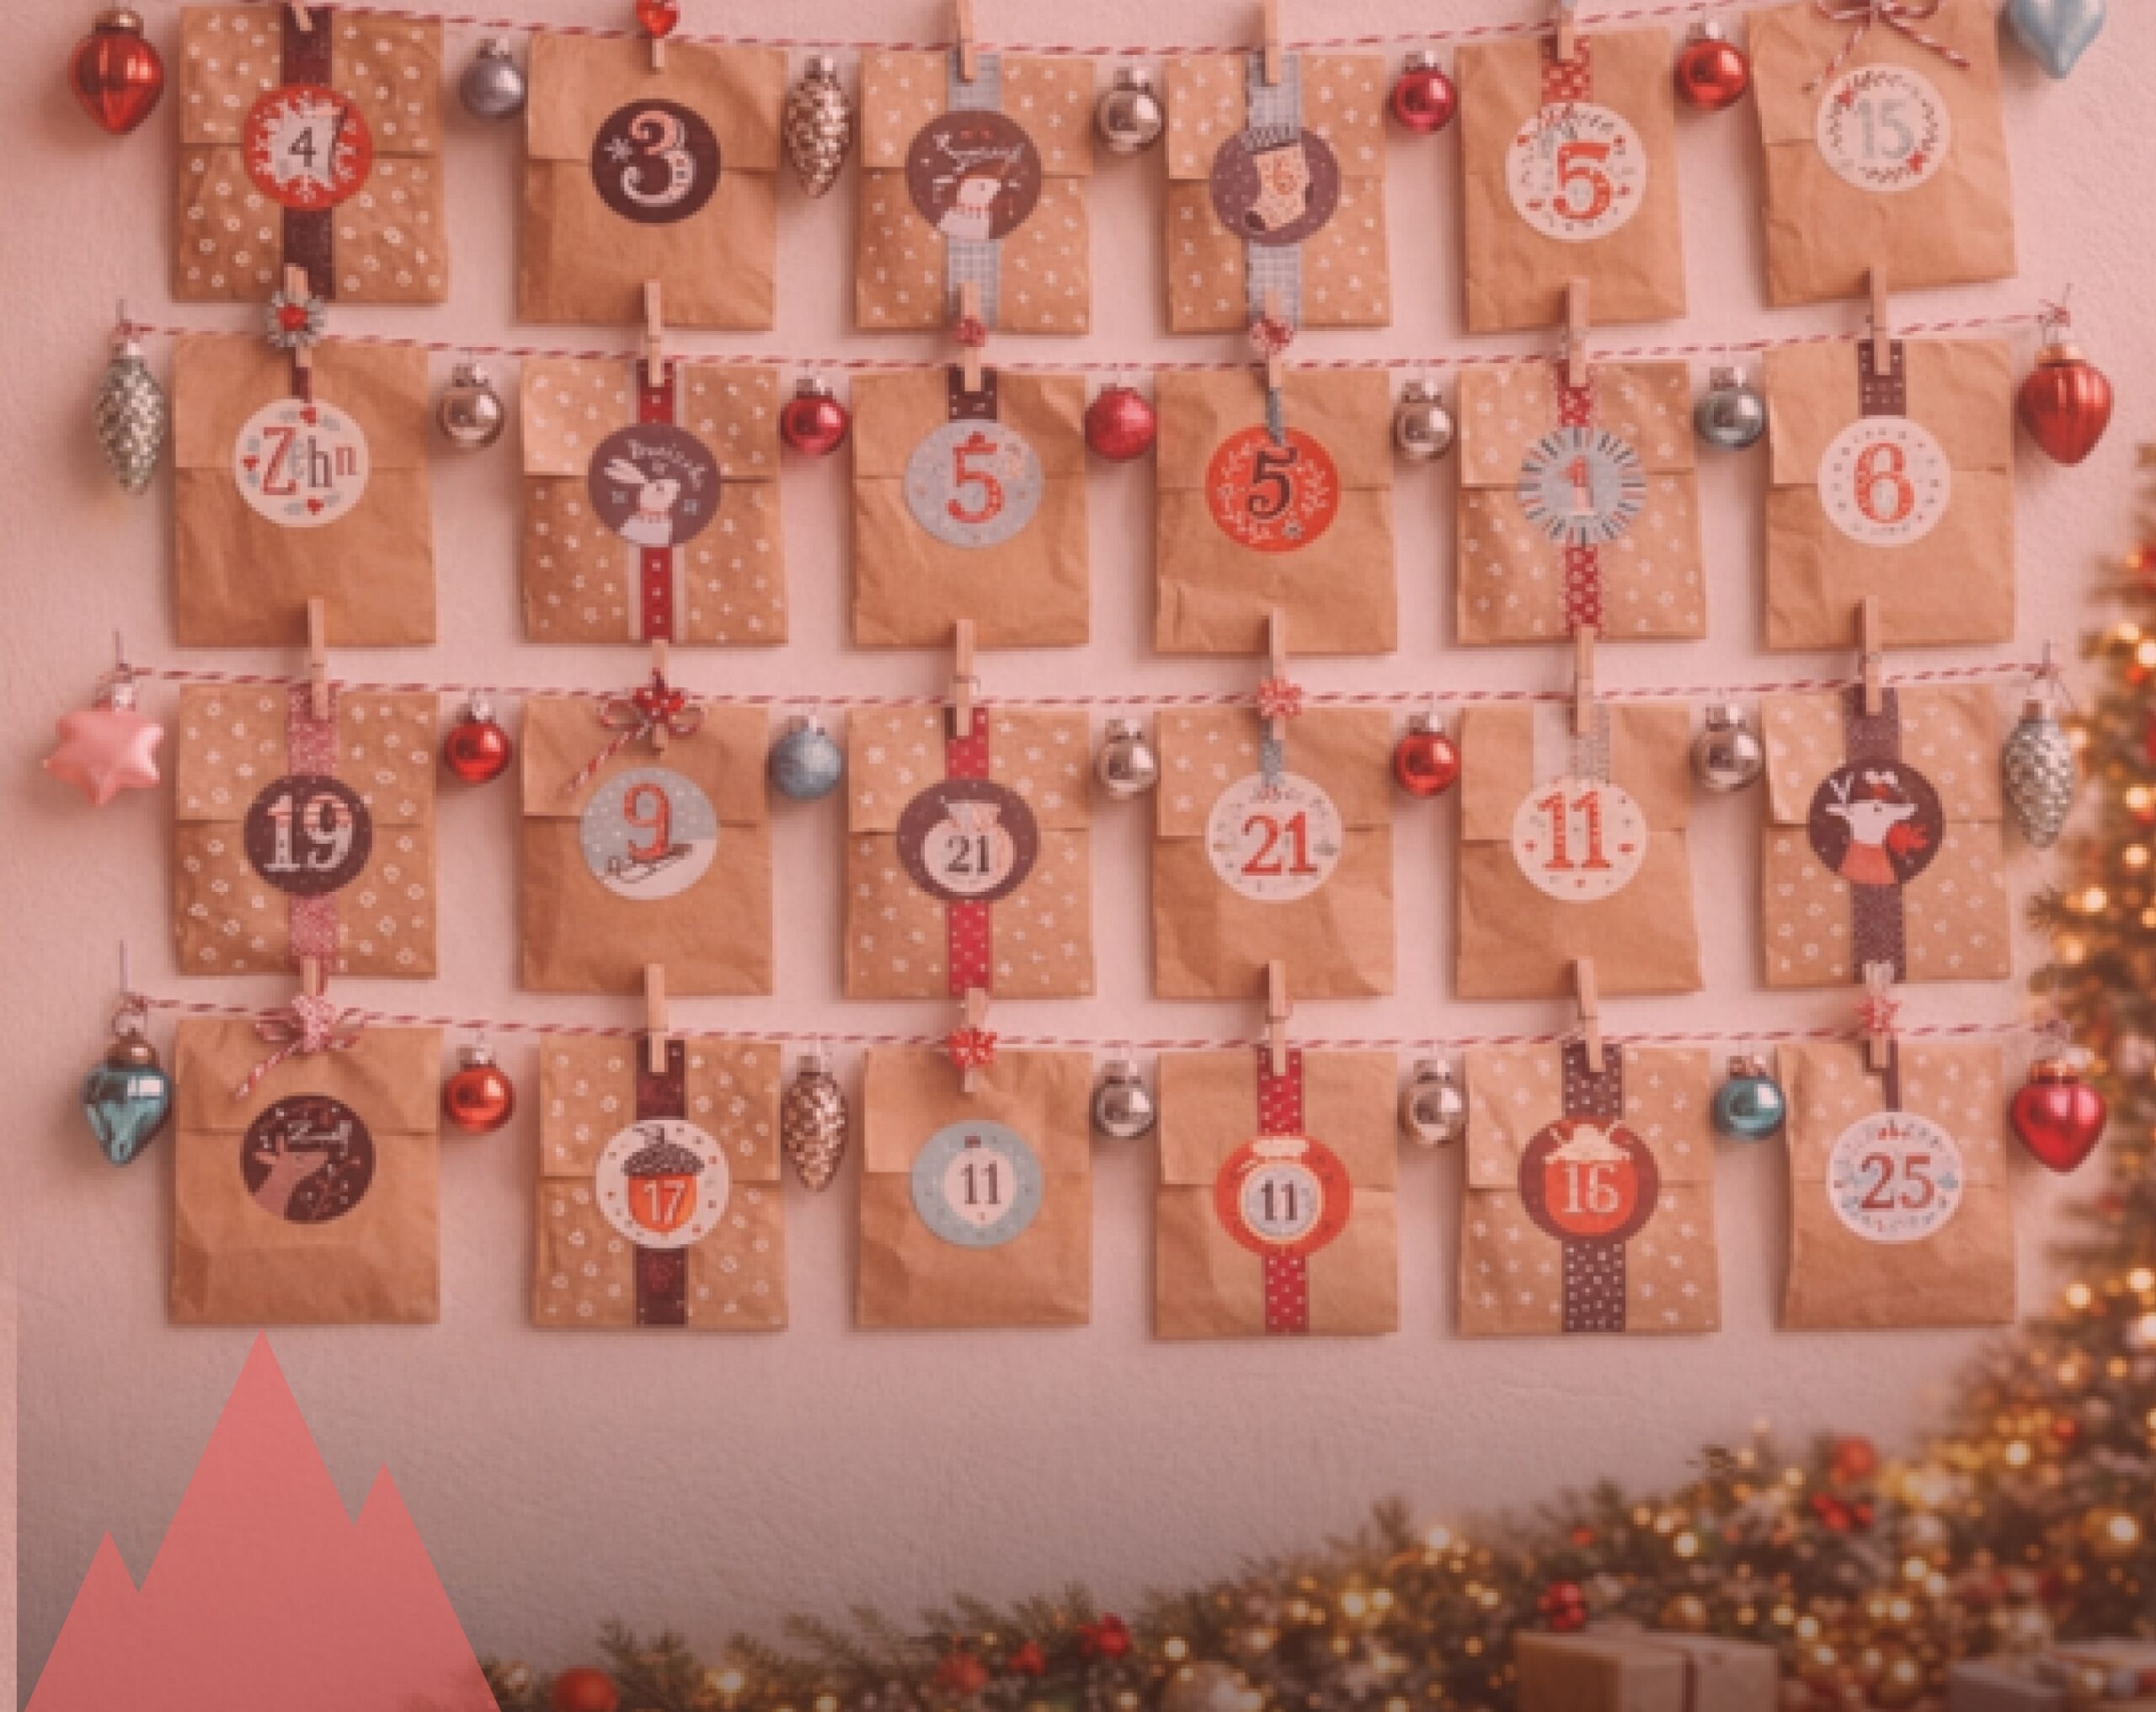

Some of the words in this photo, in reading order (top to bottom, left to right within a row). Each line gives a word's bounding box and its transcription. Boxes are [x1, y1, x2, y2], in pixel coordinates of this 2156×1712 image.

[287, 127, 318, 167] 4
[620, 109, 697, 206] 3
[1852, 97, 1914, 160] 15
[1553, 141, 1614, 219] 5
[947, 435, 1005, 524] 5
[1247, 447, 1299, 519] 5
[1564, 455, 1596, 516] 1
[1854, 442, 1914, 524] 6
[264, 793, 354, 872] 19
[623, 783, 673, 861] 9
[1241, 811, 1319, 877] 21
[1537, 791, 1611, 872] 11
[947, 835, 992, 874] 21
[643, 1179, 686, 1224] 17
[959, 1161, 1003, 1206] 11
[1260, 1179, 1299, 1222] 11
[1561, 1161, 1619, 1214] 16
[1861, 1152, 1936, 1209] 25
